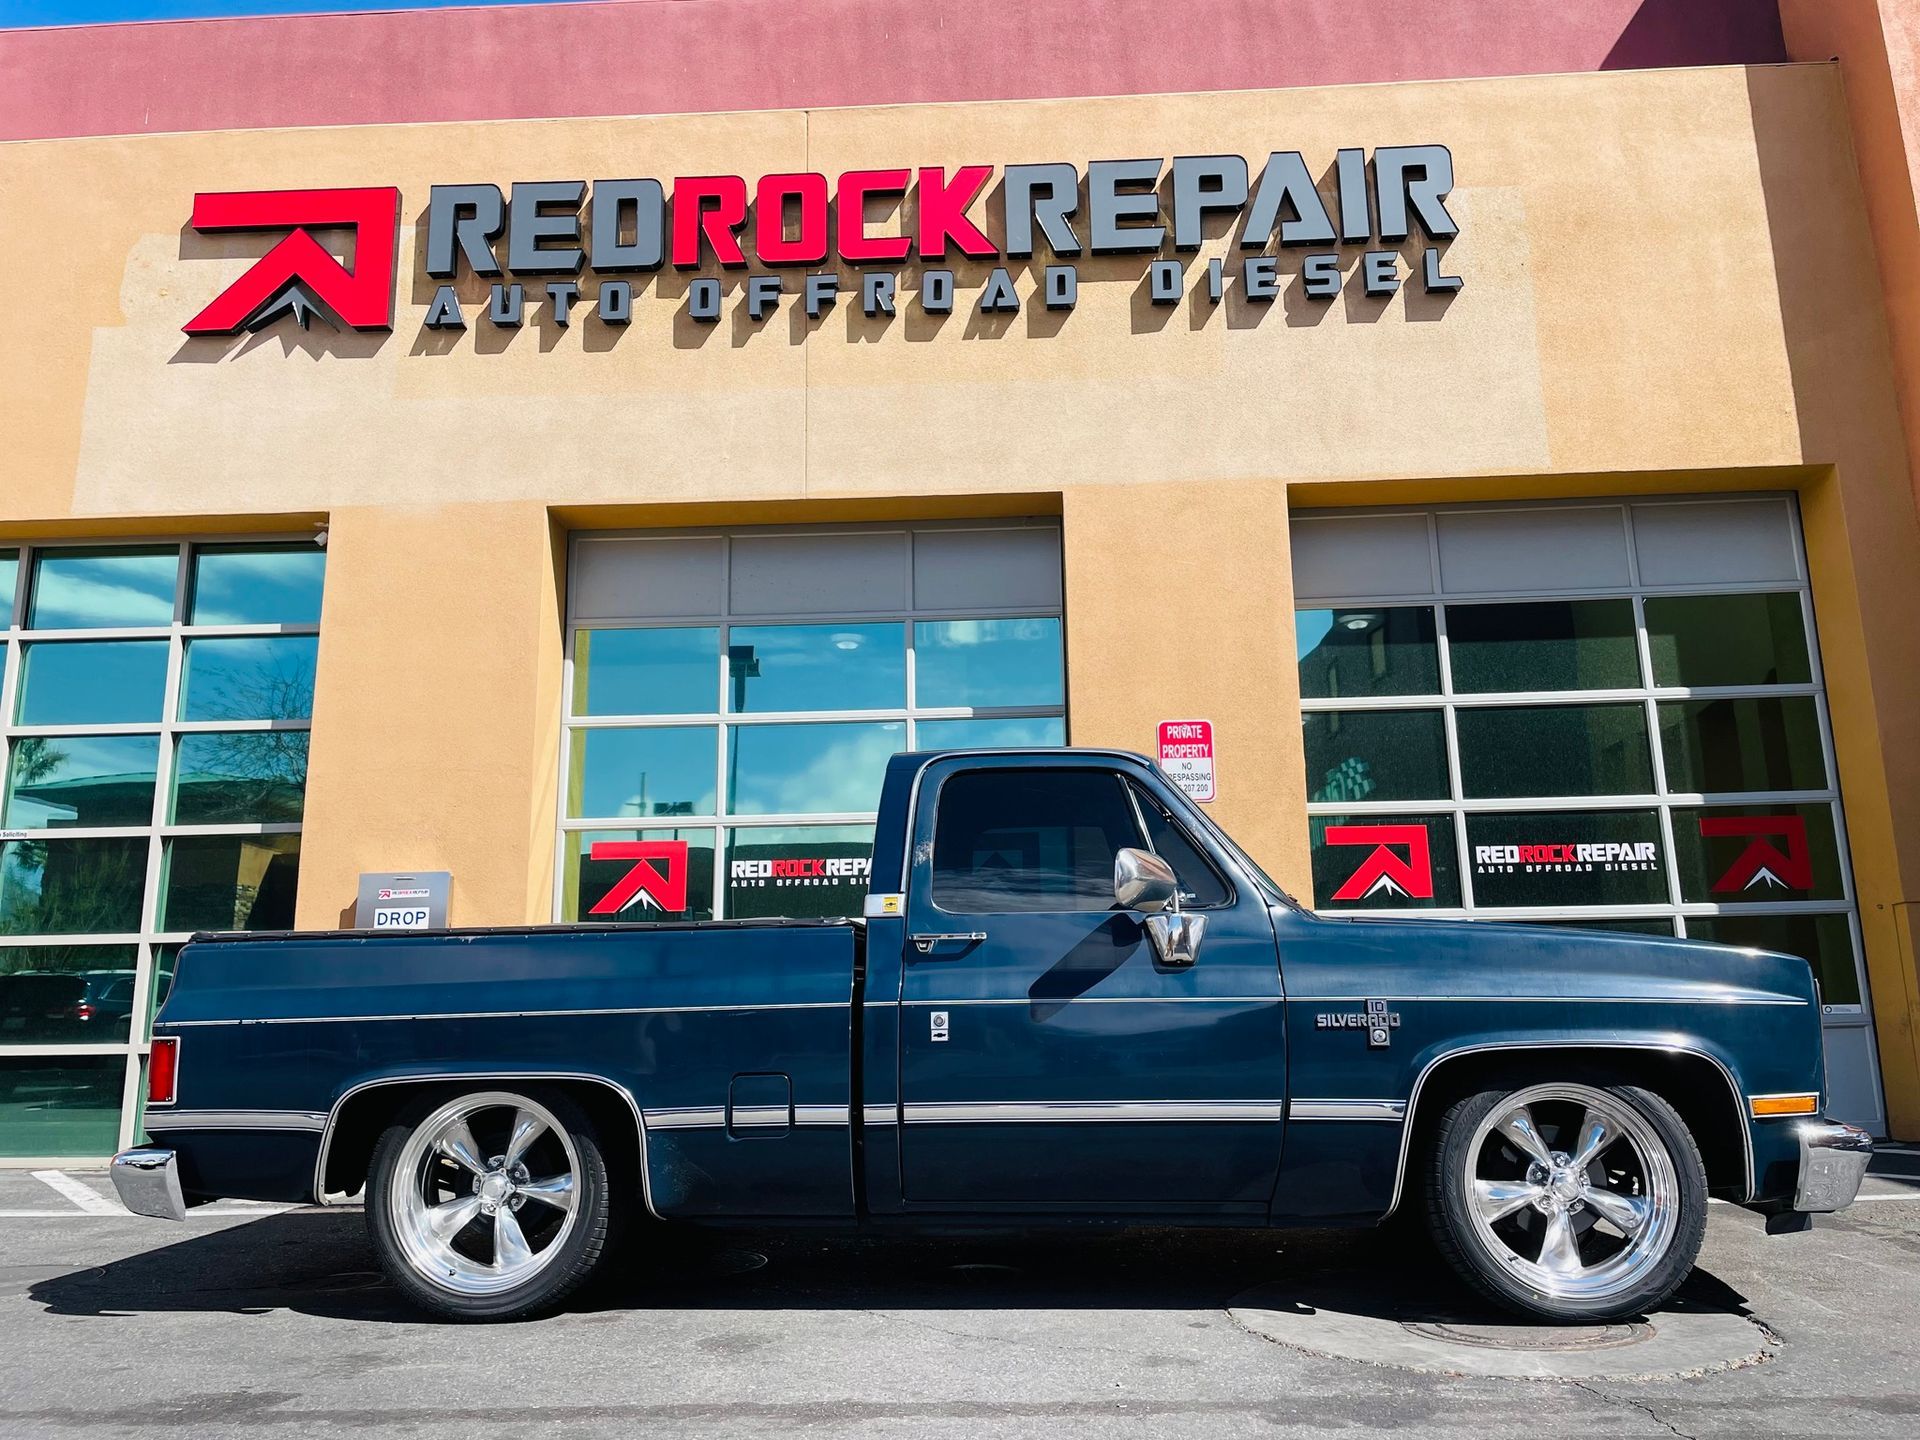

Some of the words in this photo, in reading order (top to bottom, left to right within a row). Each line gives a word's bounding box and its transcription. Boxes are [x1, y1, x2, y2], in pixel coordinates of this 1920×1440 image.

[424, 280, 631, 330] AUTO
[688, 264, 1078, 323] OFFROAD
[1151, 247, 1463, 305] DIESEL
[1166, 724, 1203, 739] PRIVATE
[1162, 743, 1210, 758] PROPERTY
[1181, 762, 1193, 771] NO
[1477, 865, 1514, 873] AUTO
[1525, 863, 1593, 873] OFFROAD
[1605, 862, 1657, 871] DIESEL
[731, 879, 765, 888] AUTO
[776, 877, 839, 887] OFFROAD
[377, 911, 427, 926] DROP
[1370, 1001, 1384, 1012] 10
[1317, 1012, 1400, 1028] SILVERADO
